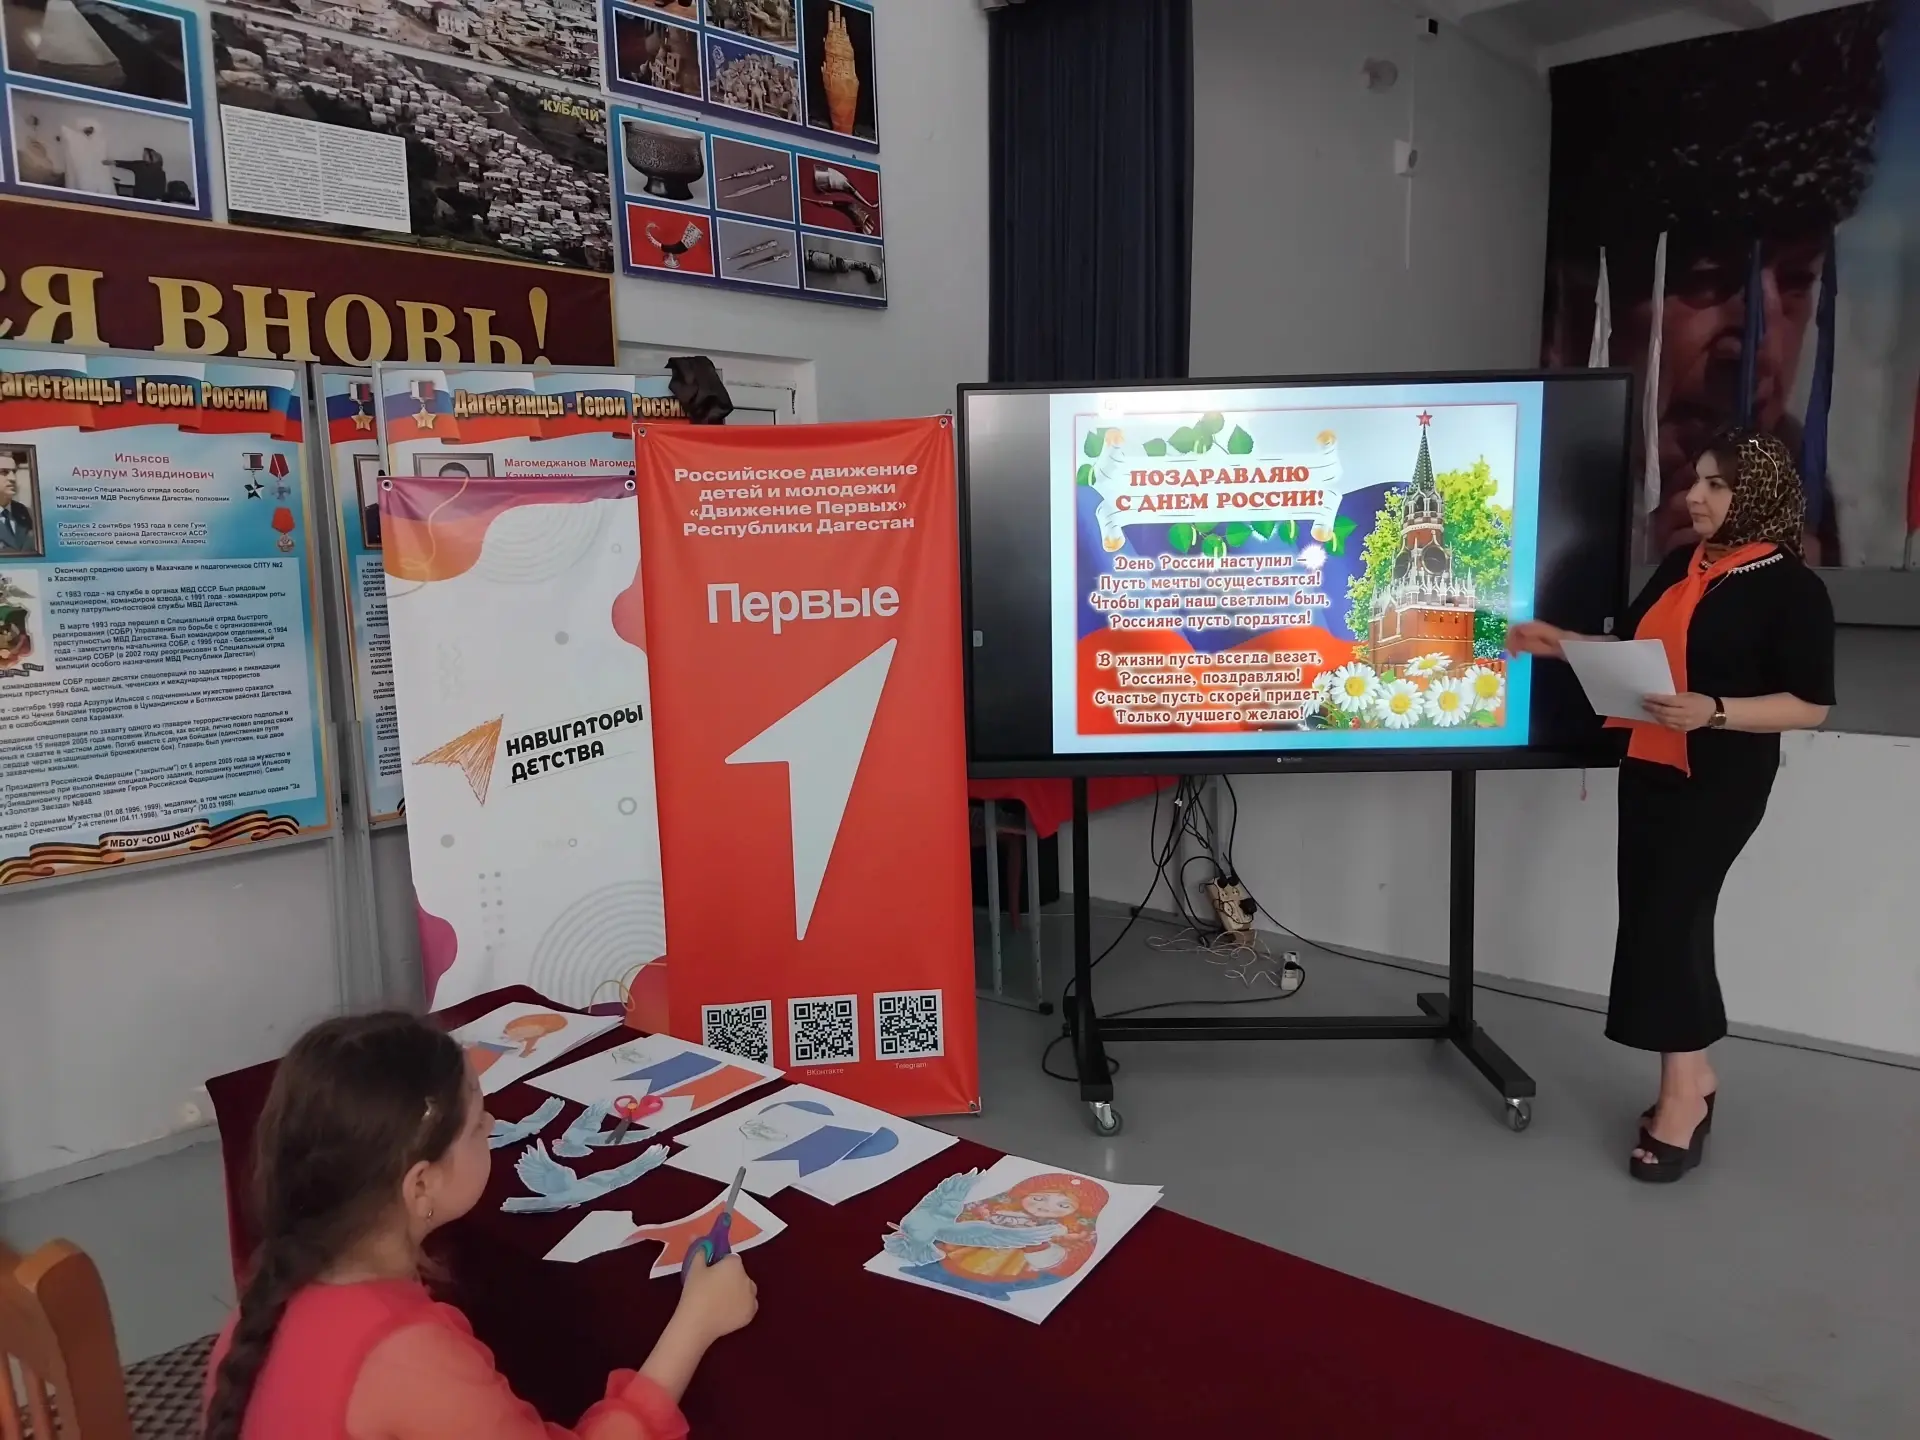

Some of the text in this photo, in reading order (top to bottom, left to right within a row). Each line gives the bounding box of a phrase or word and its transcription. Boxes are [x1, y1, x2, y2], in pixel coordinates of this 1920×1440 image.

[543, 99, 599, 122] КУБАЧИ
[0, 266, 551, 366] Я ВНОВЬ!
[0, 371, 122, 405] агестанцы
[136, 377, 195, 408] Герои
[201, 381, 268, 411] России
[454, 389, 565, 418] Дагестанцы
[576, 392, 626, 417] Герои
[114, 453, 170, 464] Ильясов
[505, 459, 636, 469] Магомеджанов Магомед
[72, 467, 214, 479] Арзулум Зиявдинович
[674, 463, 918, 483] Российское движение
[1130, 466, 1309, 487] ПОЗДРАВЛЯЮ
[699, 483, 896, 502] детей и молодежи
[1115, 490, 1324, 512] С ДНЕМ РОССИИ!
[689, 500, 907, 520] «Движение Первых»
[683, 517, 915, 539] Республики Дагестан
[1114, 556, 1154, 570] День
[1159, 556, 1215, 570] России
[1220, 555, 1292, 571] наступил
[1101, 571, 1321, 593] Пусть мечты осуществятся!
[81, 605, 155, 614] патрульно-постовой
[111, 596, 155, 604] командиром
[707, 583, 900, 635] Первые
[1090, 591, 1330, 611] Чтобы край наш светлым был,
[167, 616, 215, 625] Специальный
[237, 614, 268, 622] быстрого
[1110, 611, 1311, 630] Россияне пусть гордятся!
[53, 630, 105, 639] реагирования
[106, 628, 133, 636] (СОБР)
[135, 626, 176, 634] Управления
[220, 621, 273, 629] организованной
[1097, 652, 1322, 669] В жизни пусть всегда везет,
[1119, 668, 1301, 686] Россияне, поздравляю!
[1094, 689, 1325, 707] Счастье пусть скорей придет,
[1116, 706, 1305, 725] Только лучшего желаю!
[506, 704, 644, 756] НАВИГАТОРЫ
[511, 740, 604, 783] ДЕТСТВА
[6, 771, 133, 792] Президента Российской Федерации
[110, 838, 139, 848] МБОУ
[806, 1067, 844, 1077] ВКонтакте
[895, 1062, 927, 1071] Telegram
